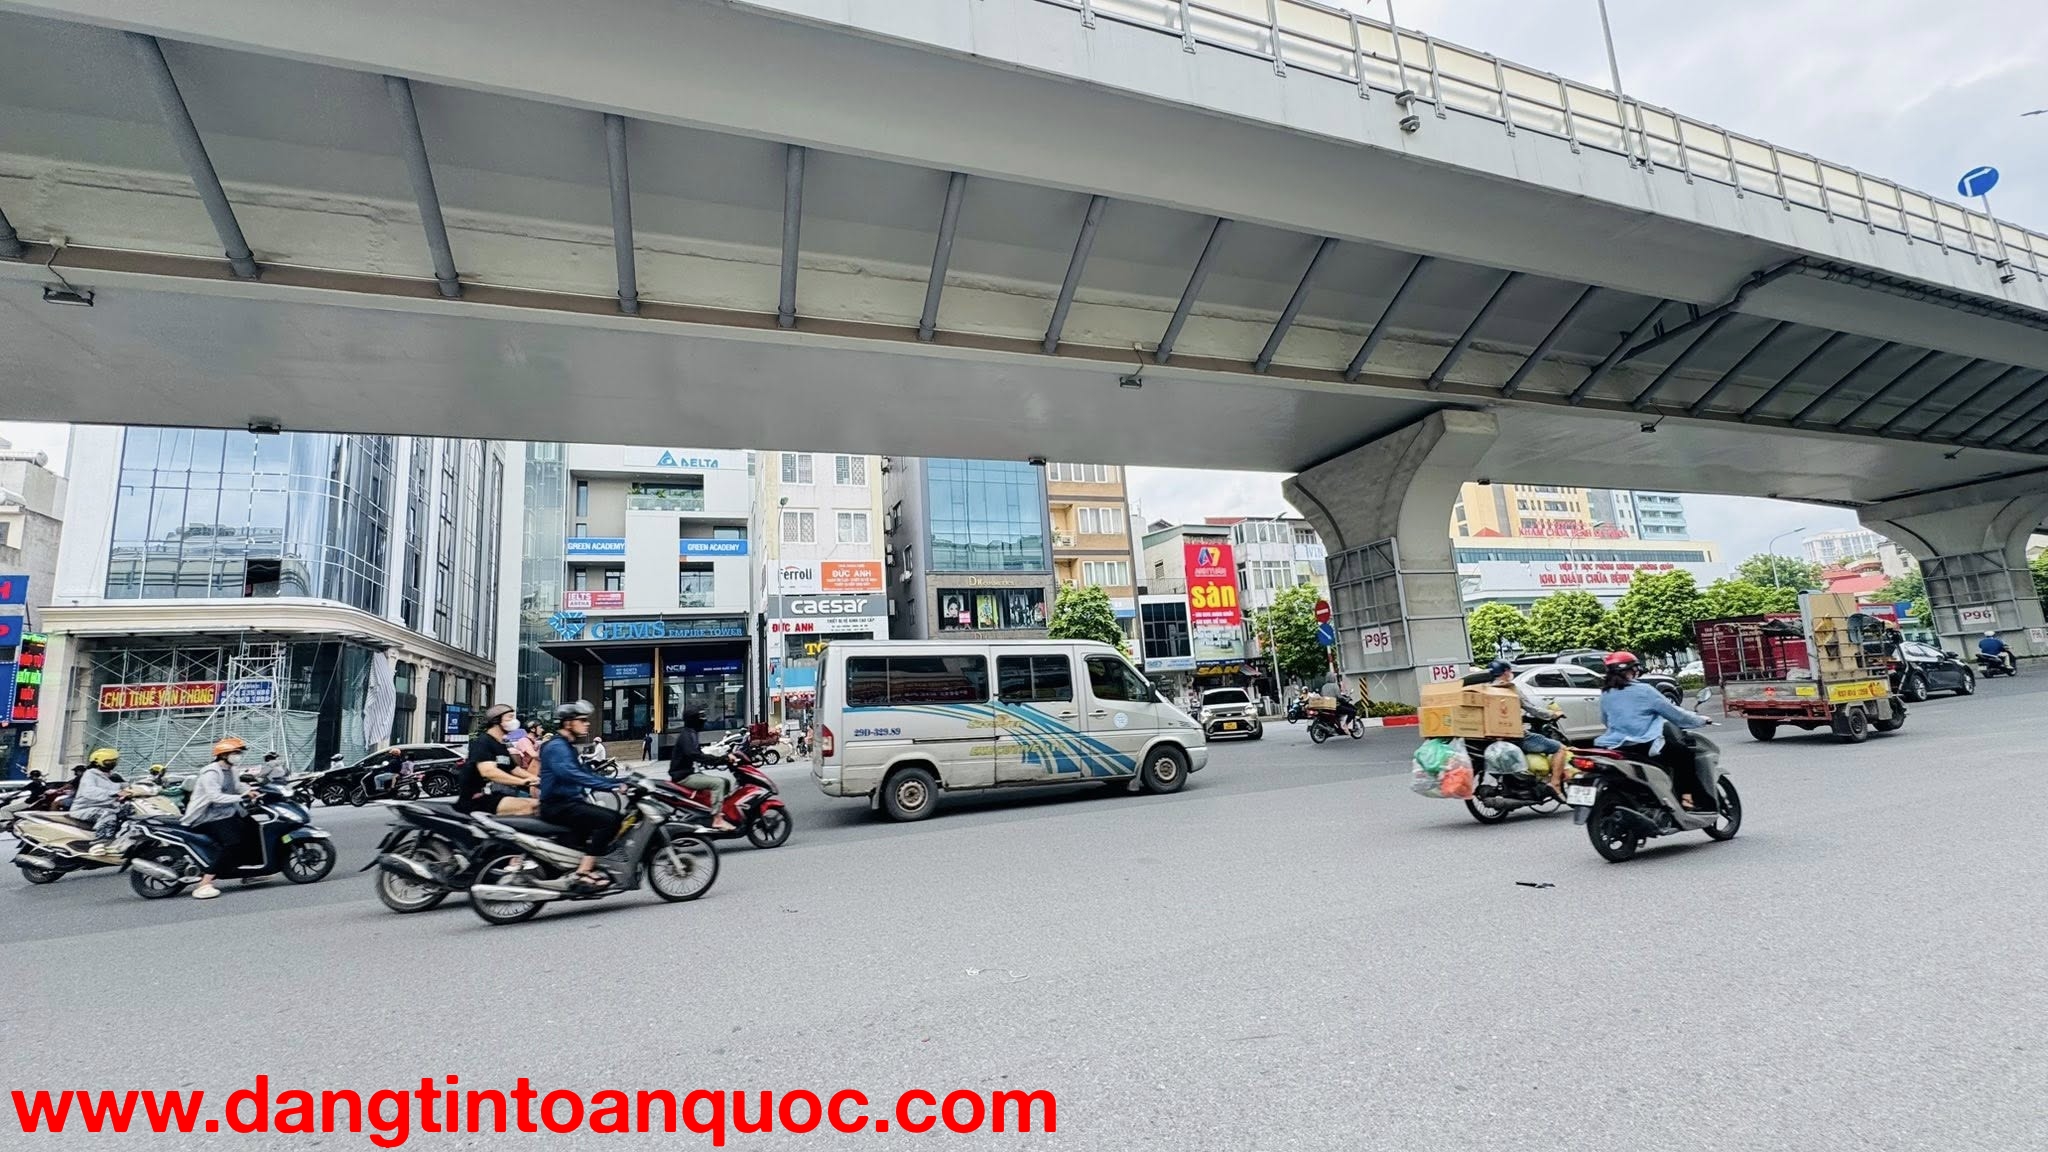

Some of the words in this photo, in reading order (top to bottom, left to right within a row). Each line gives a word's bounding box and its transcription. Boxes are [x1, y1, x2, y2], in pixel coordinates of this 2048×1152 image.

[681, 458, 719, 468] DELTA
[568, 542, 591, 551] GREEN
[592, 542, 625, 551] ACADEMY
[687, 543, 708, 551] GREEN
[710, 543, 739, 551] ACADEMY
[853, 569, 872, 577] ANH
[568, 592, 591, 600] IELTS
[1191, 581, 1236, 608] sàn
[1963, 610, 1992, 620] P96
[591, 620, 666, 640] GEMS
[668, 629, 706, 638] EMPIRE
[709, 628, 743, 637] TOWER
[795, 623, 814, 632] ANH
[1365, 632, 1389, 648] P95
[666, 664, 686, 672] NCB
[1433, 665, 1456, 680] P95
[104, 691, 126, 707] CHO
[129, 687, 155, 706] THUÊ
[180, 685, 214, 705] PHÒNG
